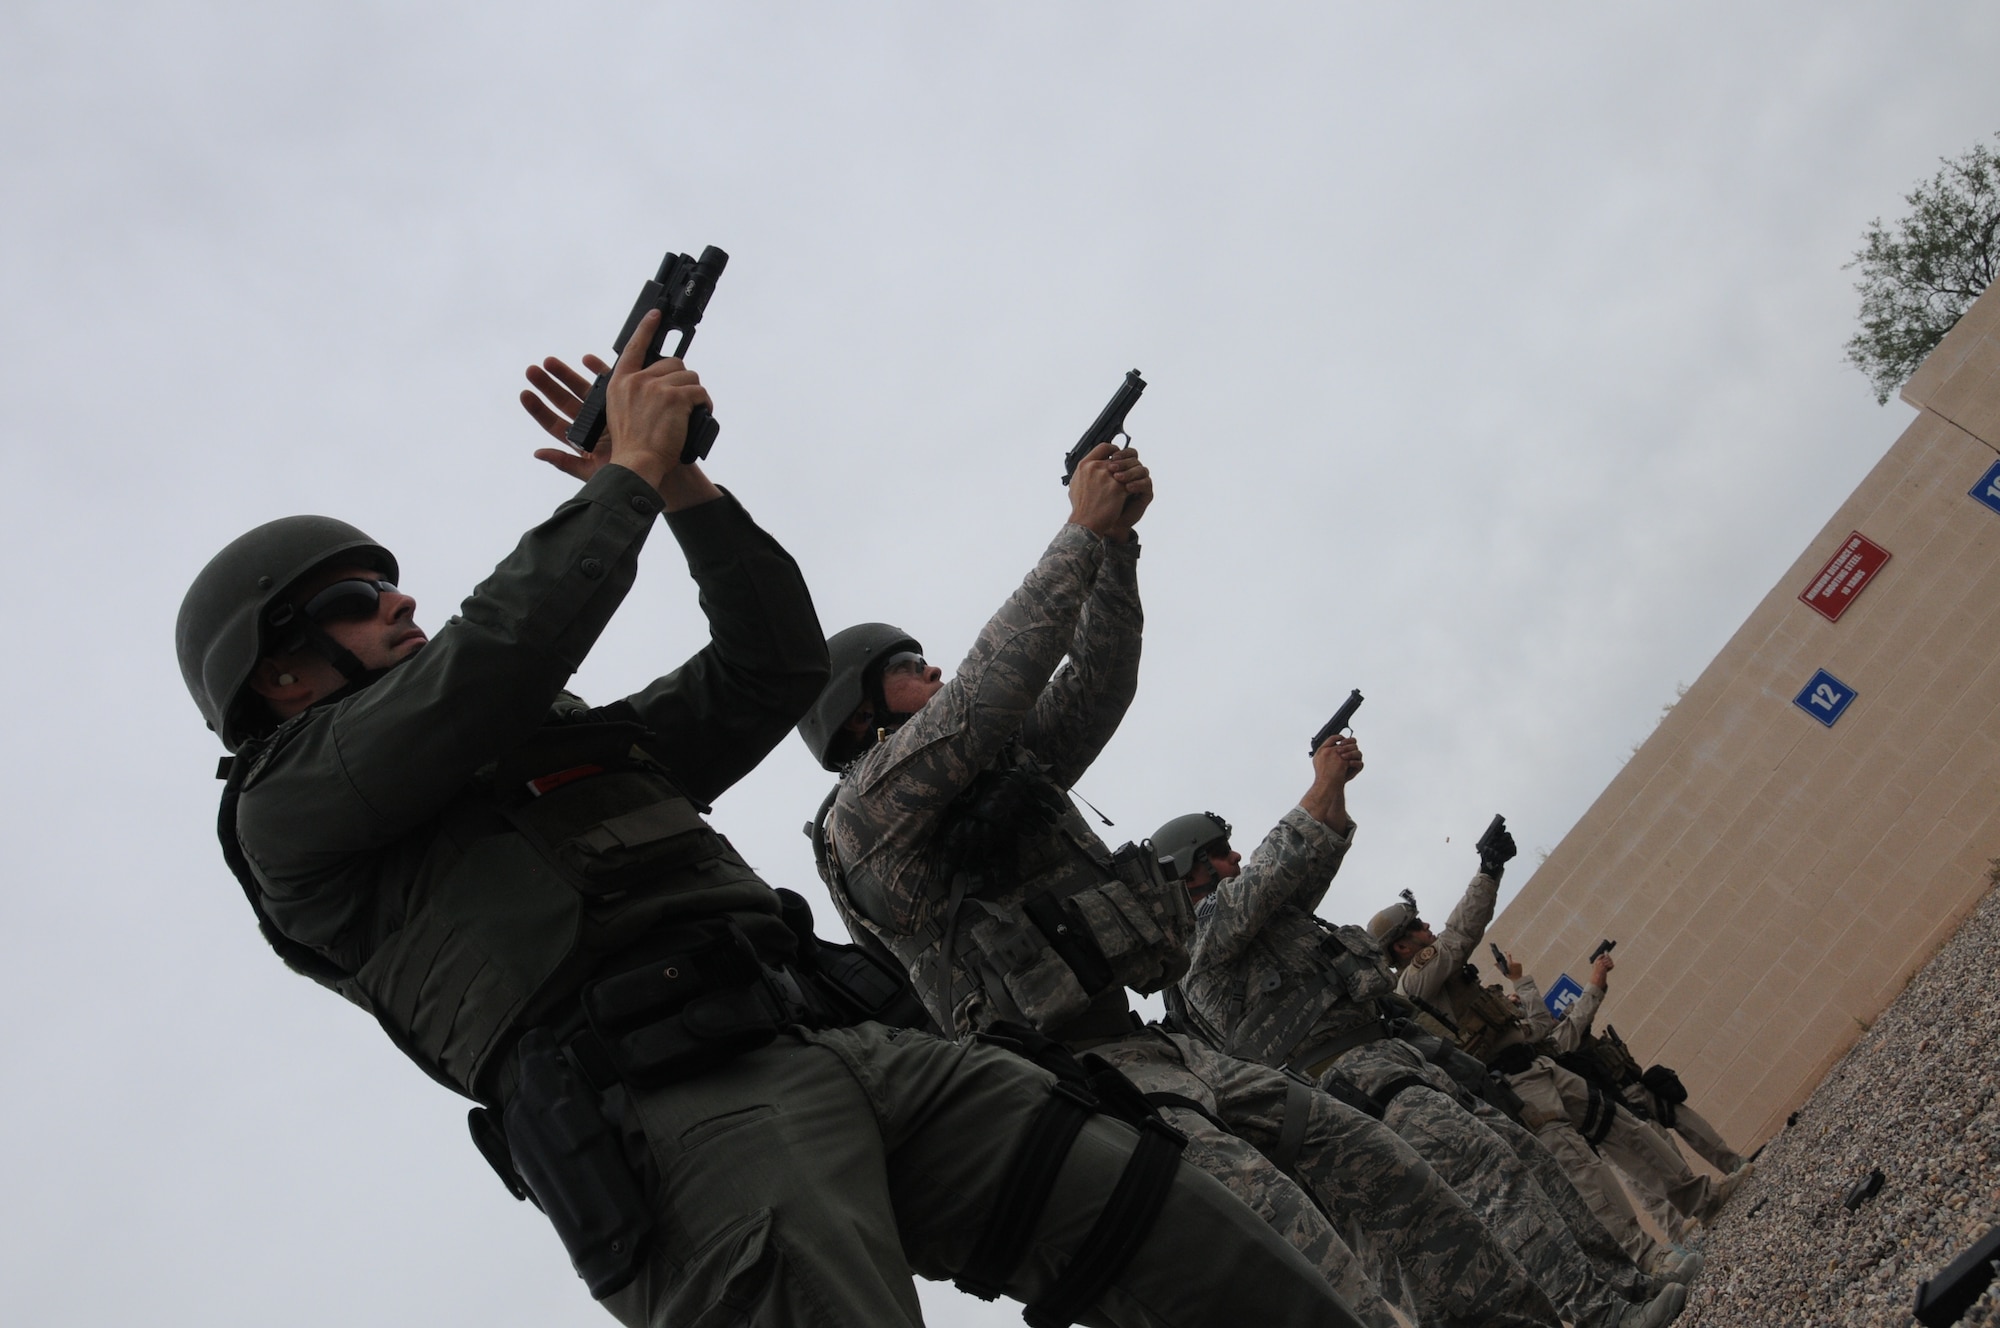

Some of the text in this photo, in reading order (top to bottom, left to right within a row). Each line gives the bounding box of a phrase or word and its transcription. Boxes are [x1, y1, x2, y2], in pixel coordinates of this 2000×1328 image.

[1806, 537, 1862, 601] MINIMUM DISTANCE FOR
[1822, 553, 1863, 598] SHOOTING STEEL:
[1846, 569, 1866, 588] YARDS
[1810, 683, 1842, 711] 12
[1554, 988, 1580, 1012] 15
